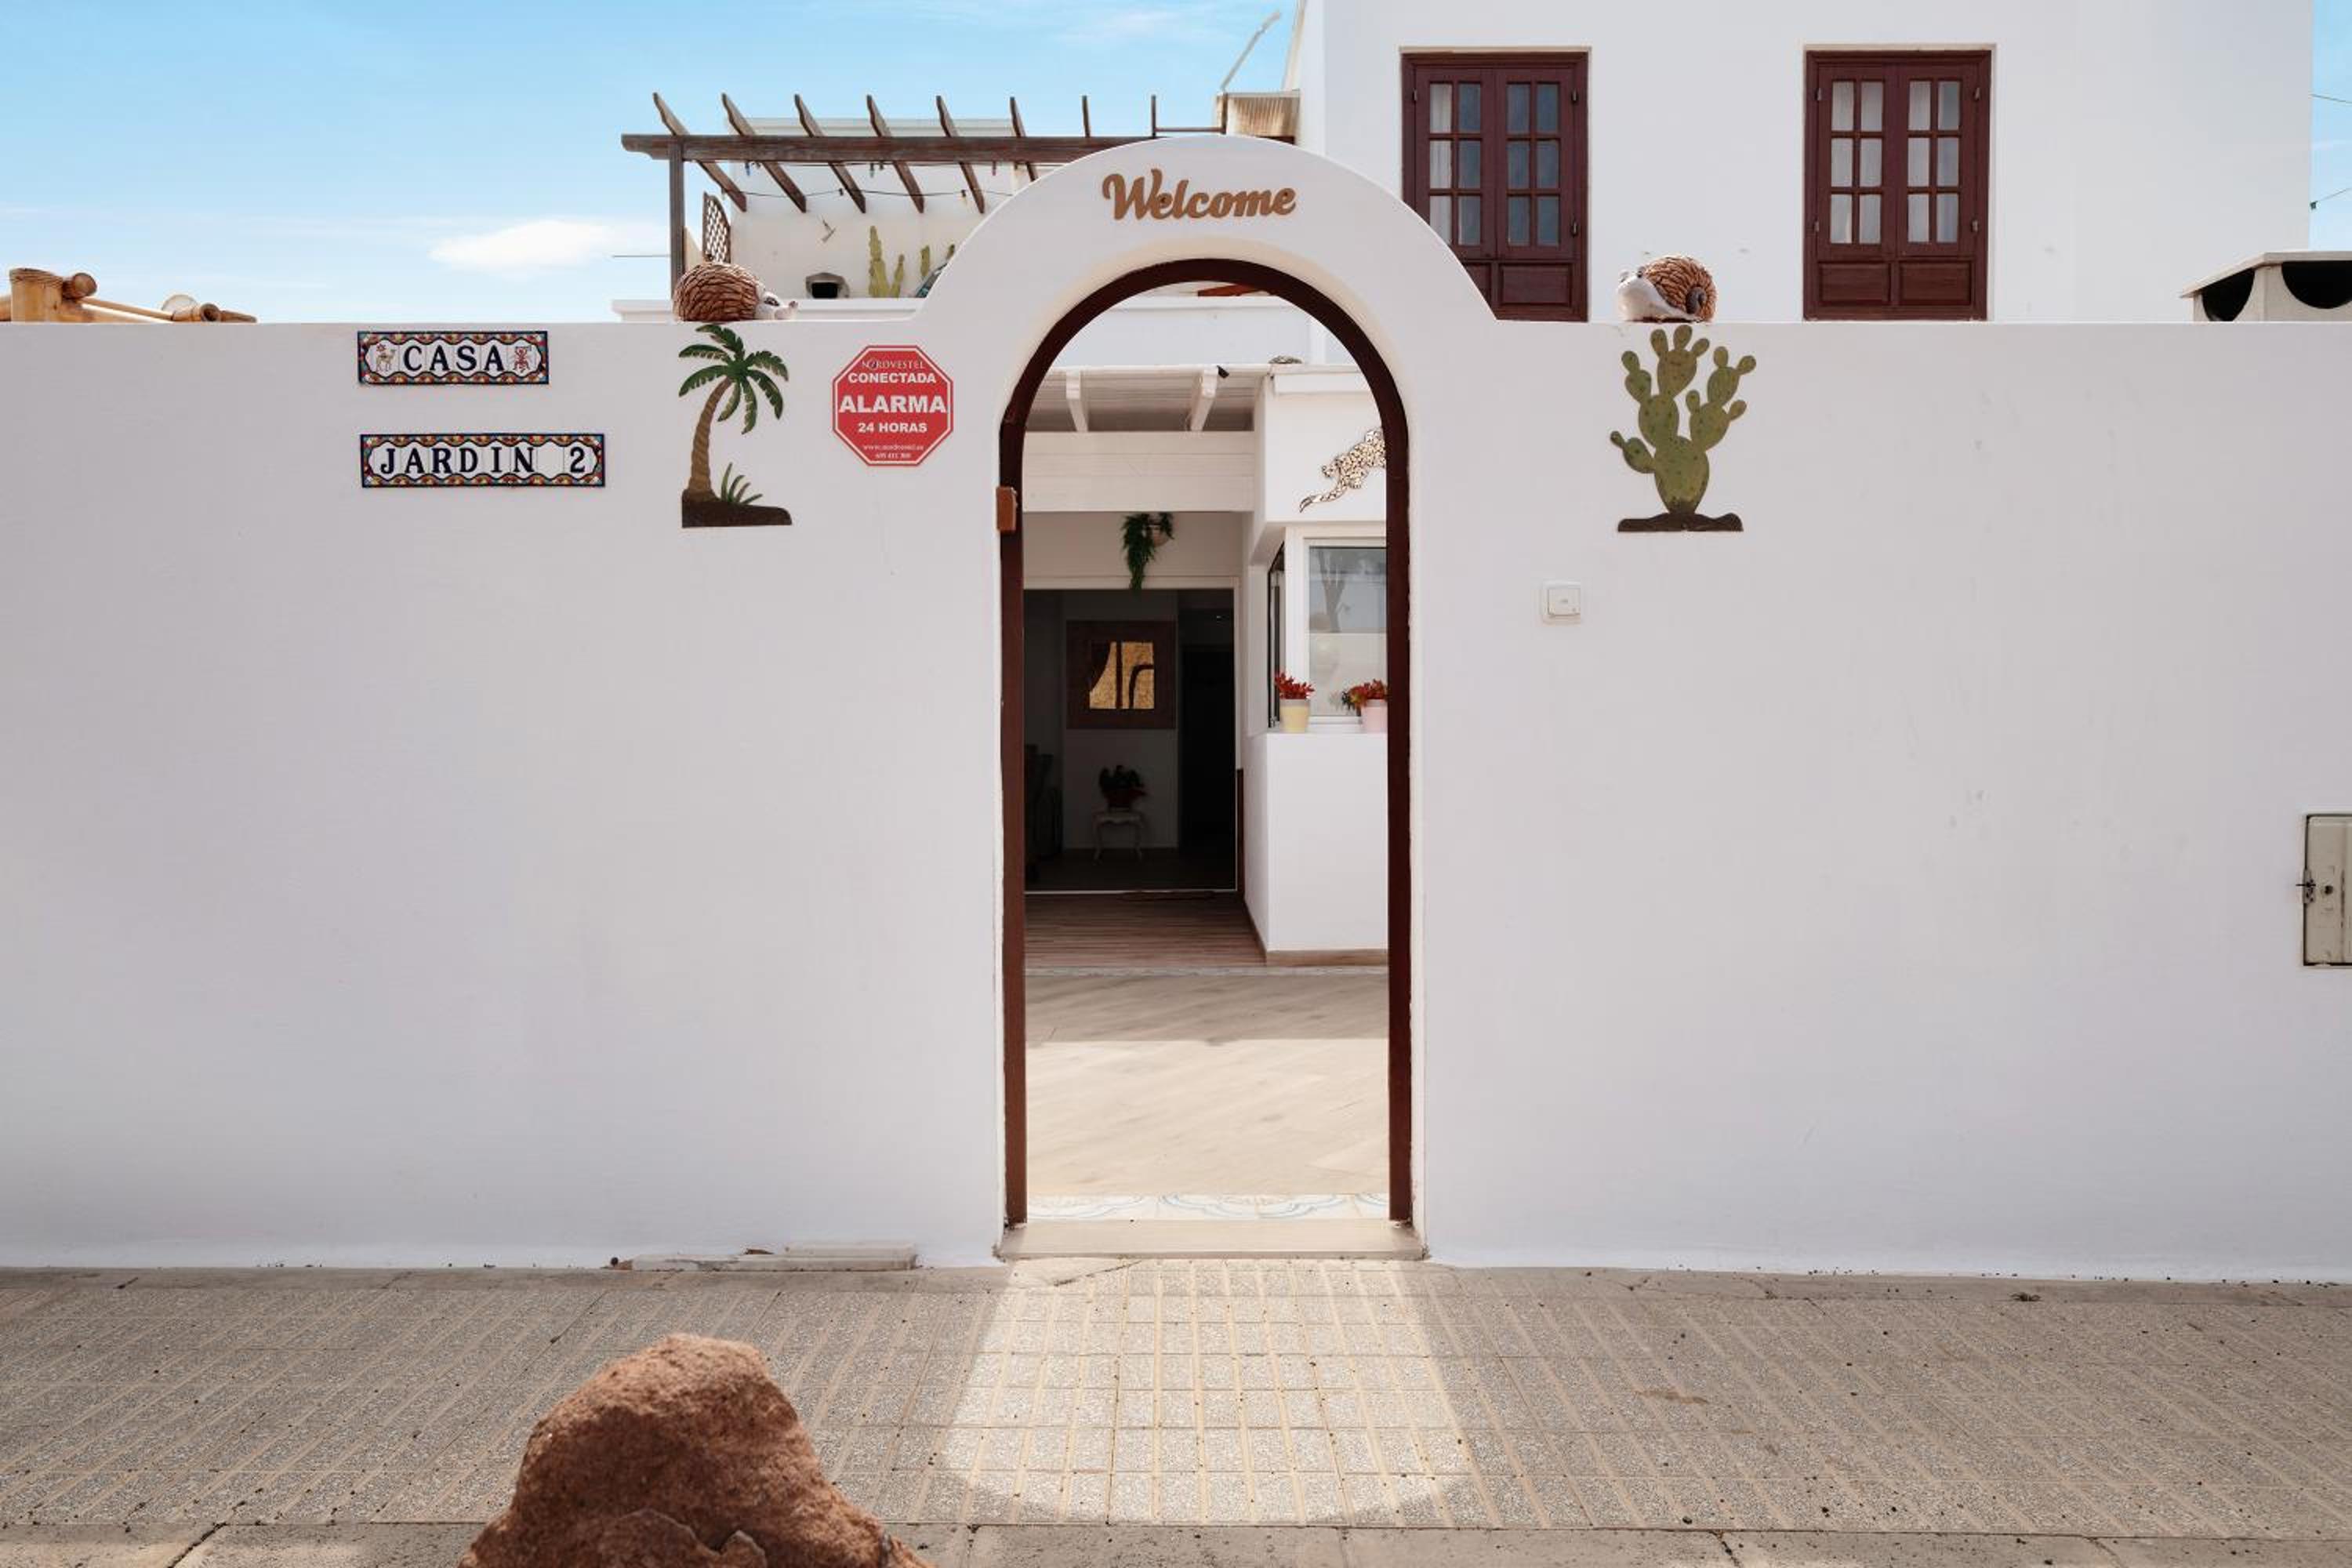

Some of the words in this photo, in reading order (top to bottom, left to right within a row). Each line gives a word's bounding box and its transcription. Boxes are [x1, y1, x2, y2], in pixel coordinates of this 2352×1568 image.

[1102, 169, 1297, 220] Welcome
[403, 345, 504, 372] CASA
[848, 372, 937, 383] CONECTADA
[838, 394, 947, 414] ALARMA
[858, 423, 874, 433] 24
[878, 423, 927, 433] HORAS
[380, 447, 535, 474] JARDIN
[569, 447, 586, 473] 2
